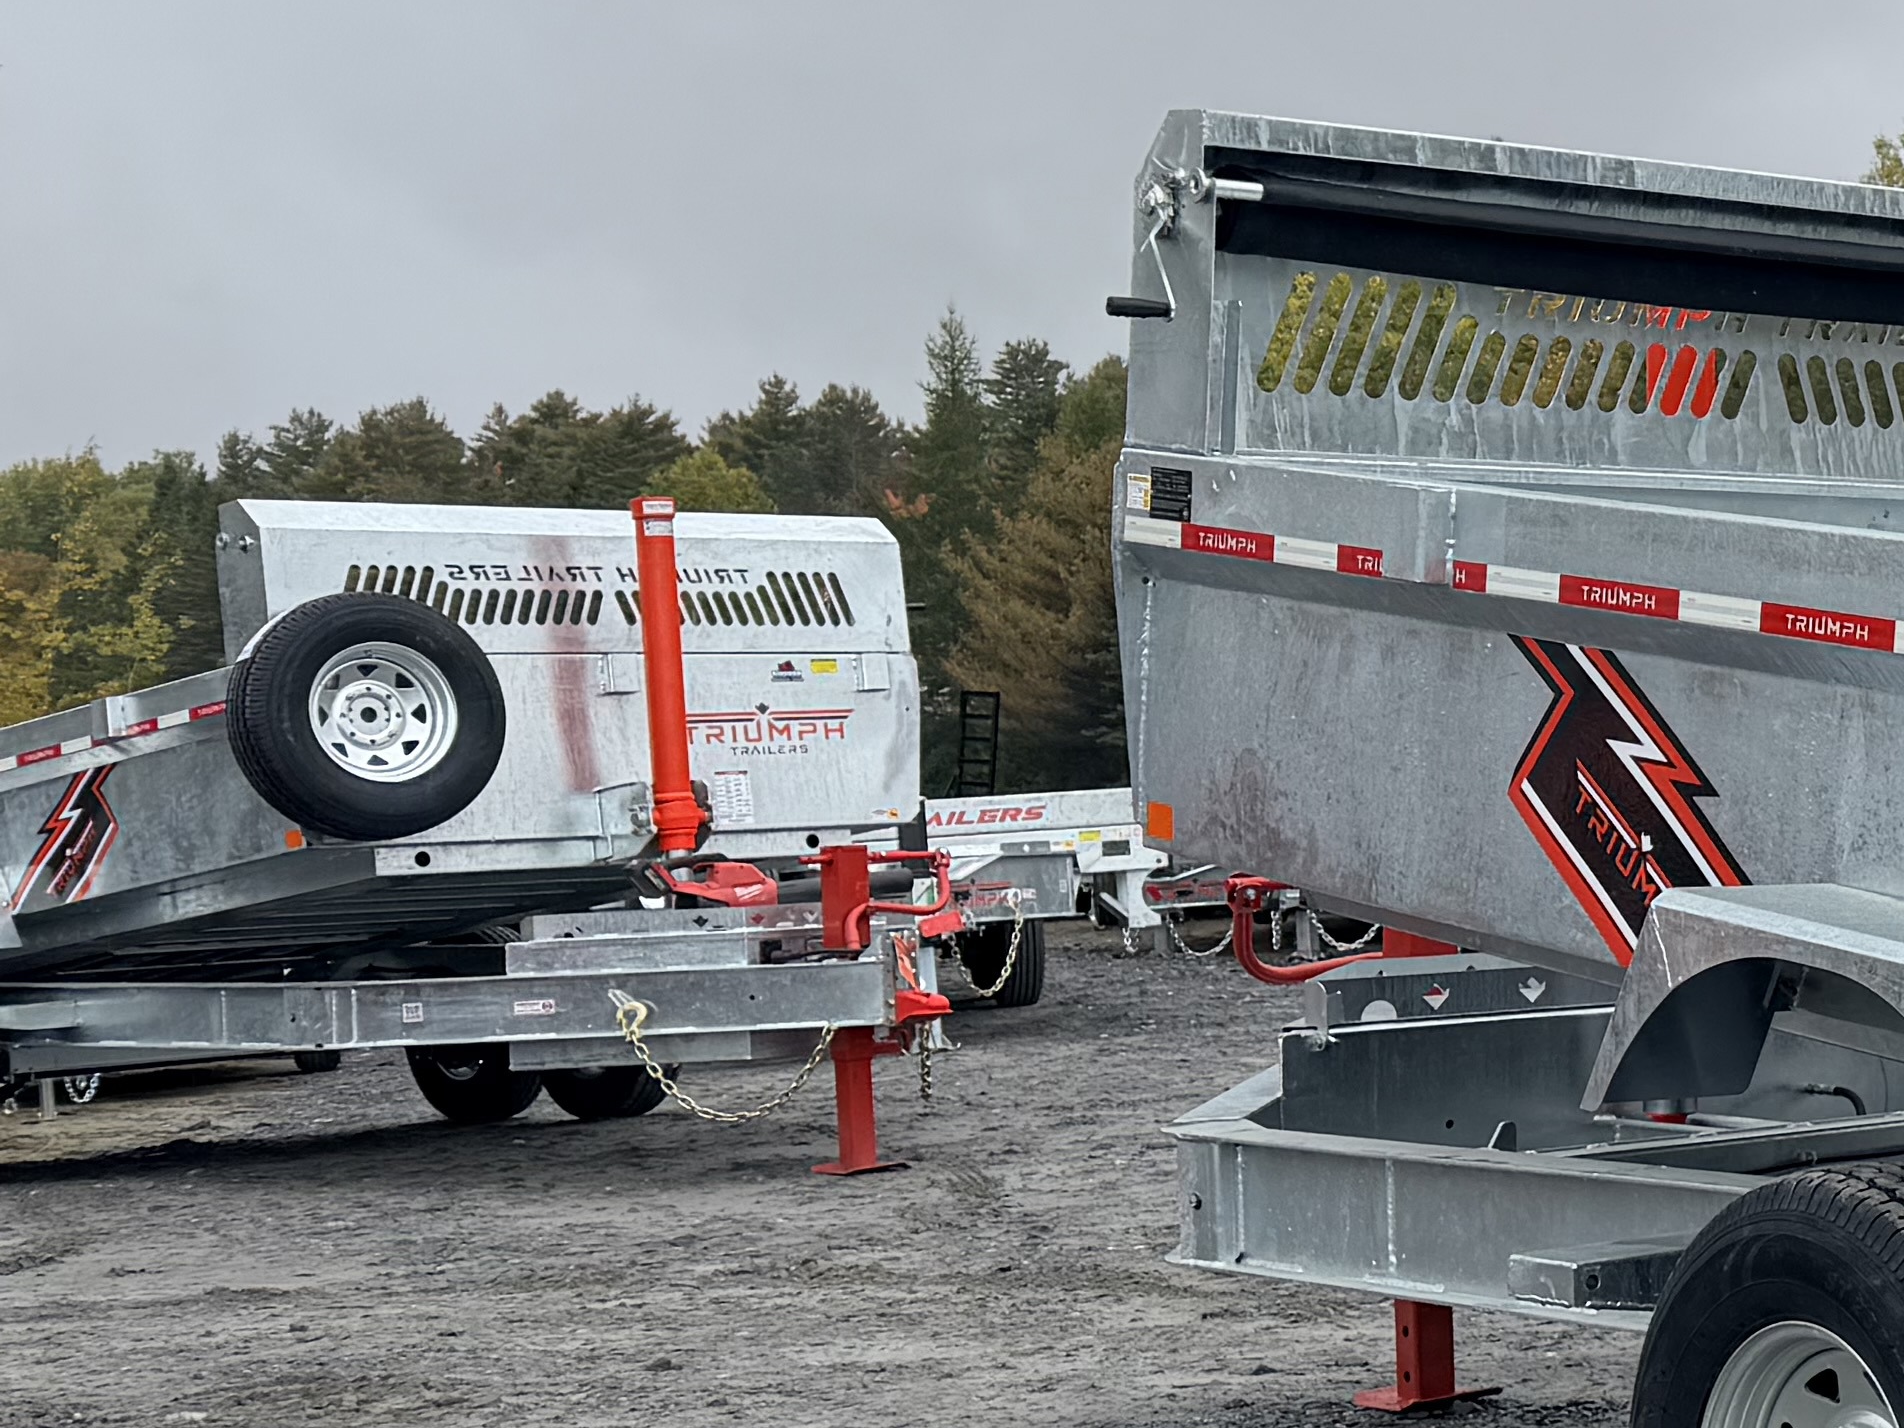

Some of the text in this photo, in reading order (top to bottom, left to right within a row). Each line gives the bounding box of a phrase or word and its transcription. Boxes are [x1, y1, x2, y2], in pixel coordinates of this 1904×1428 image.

[1198, 532, 1257, 553] TRIUMPH
[1580, 585, 1657, 610] TRIUMPH
[1785, 613, 1869, 641] TRIUMPH
[686, 722, 846, 744] TRIUMPH
[730, 745, 809, 756] TRAILERS
[928, 805, 1047, 826] AILERS
[1576, 785, 1657, 908] TRIUM
